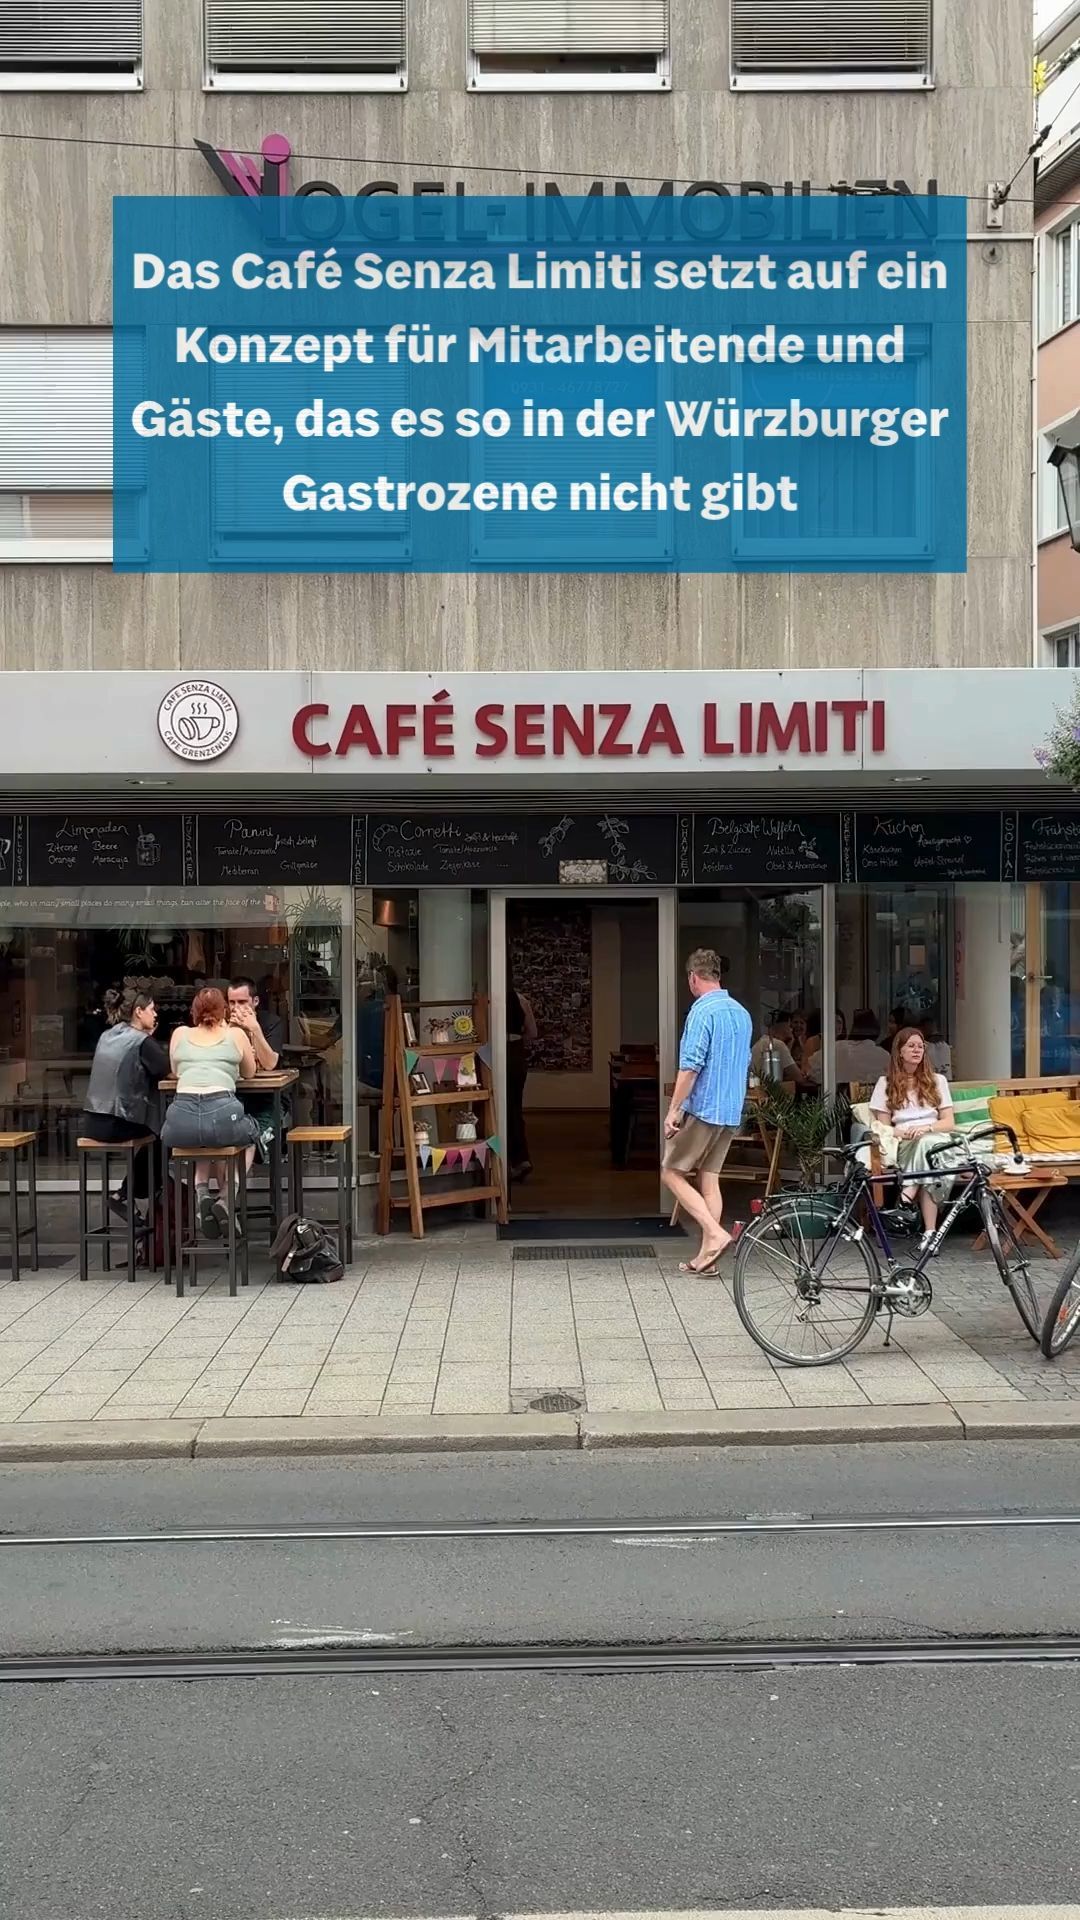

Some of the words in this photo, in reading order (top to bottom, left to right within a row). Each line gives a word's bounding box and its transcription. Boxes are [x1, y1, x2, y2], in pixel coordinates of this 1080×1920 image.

[181, 684, 210, 694] SENZA
[211, 689, 232, 712] LIMITI
[291, 691, 454, 757] CAFÉ
[475, 704, 683, 757] SENZA
[703, 700, 885, 754] LIMITI
[182, 731, 233, 757] GRENZENLOS
[56, 818, 129, 841] Limonaden
[224, 818, 274, 839] Panini
[400, 820, 462, 841] Cornetti
[707, 817, 760, 845] Belgische
[760, 817, 807, 841] Waffeln
[873, 816, 926, 839] Kuchen
[92, 840, 119, 851] Beere
[185, 816, 195, 880] ZUSAMMEN
[354, 818, 365, 884] TEILHABE
[680, 817, 690, 879] CHANCEN
[48, 855, 78, 869] Orange
[92, 855, 129, 870] Maracuja
